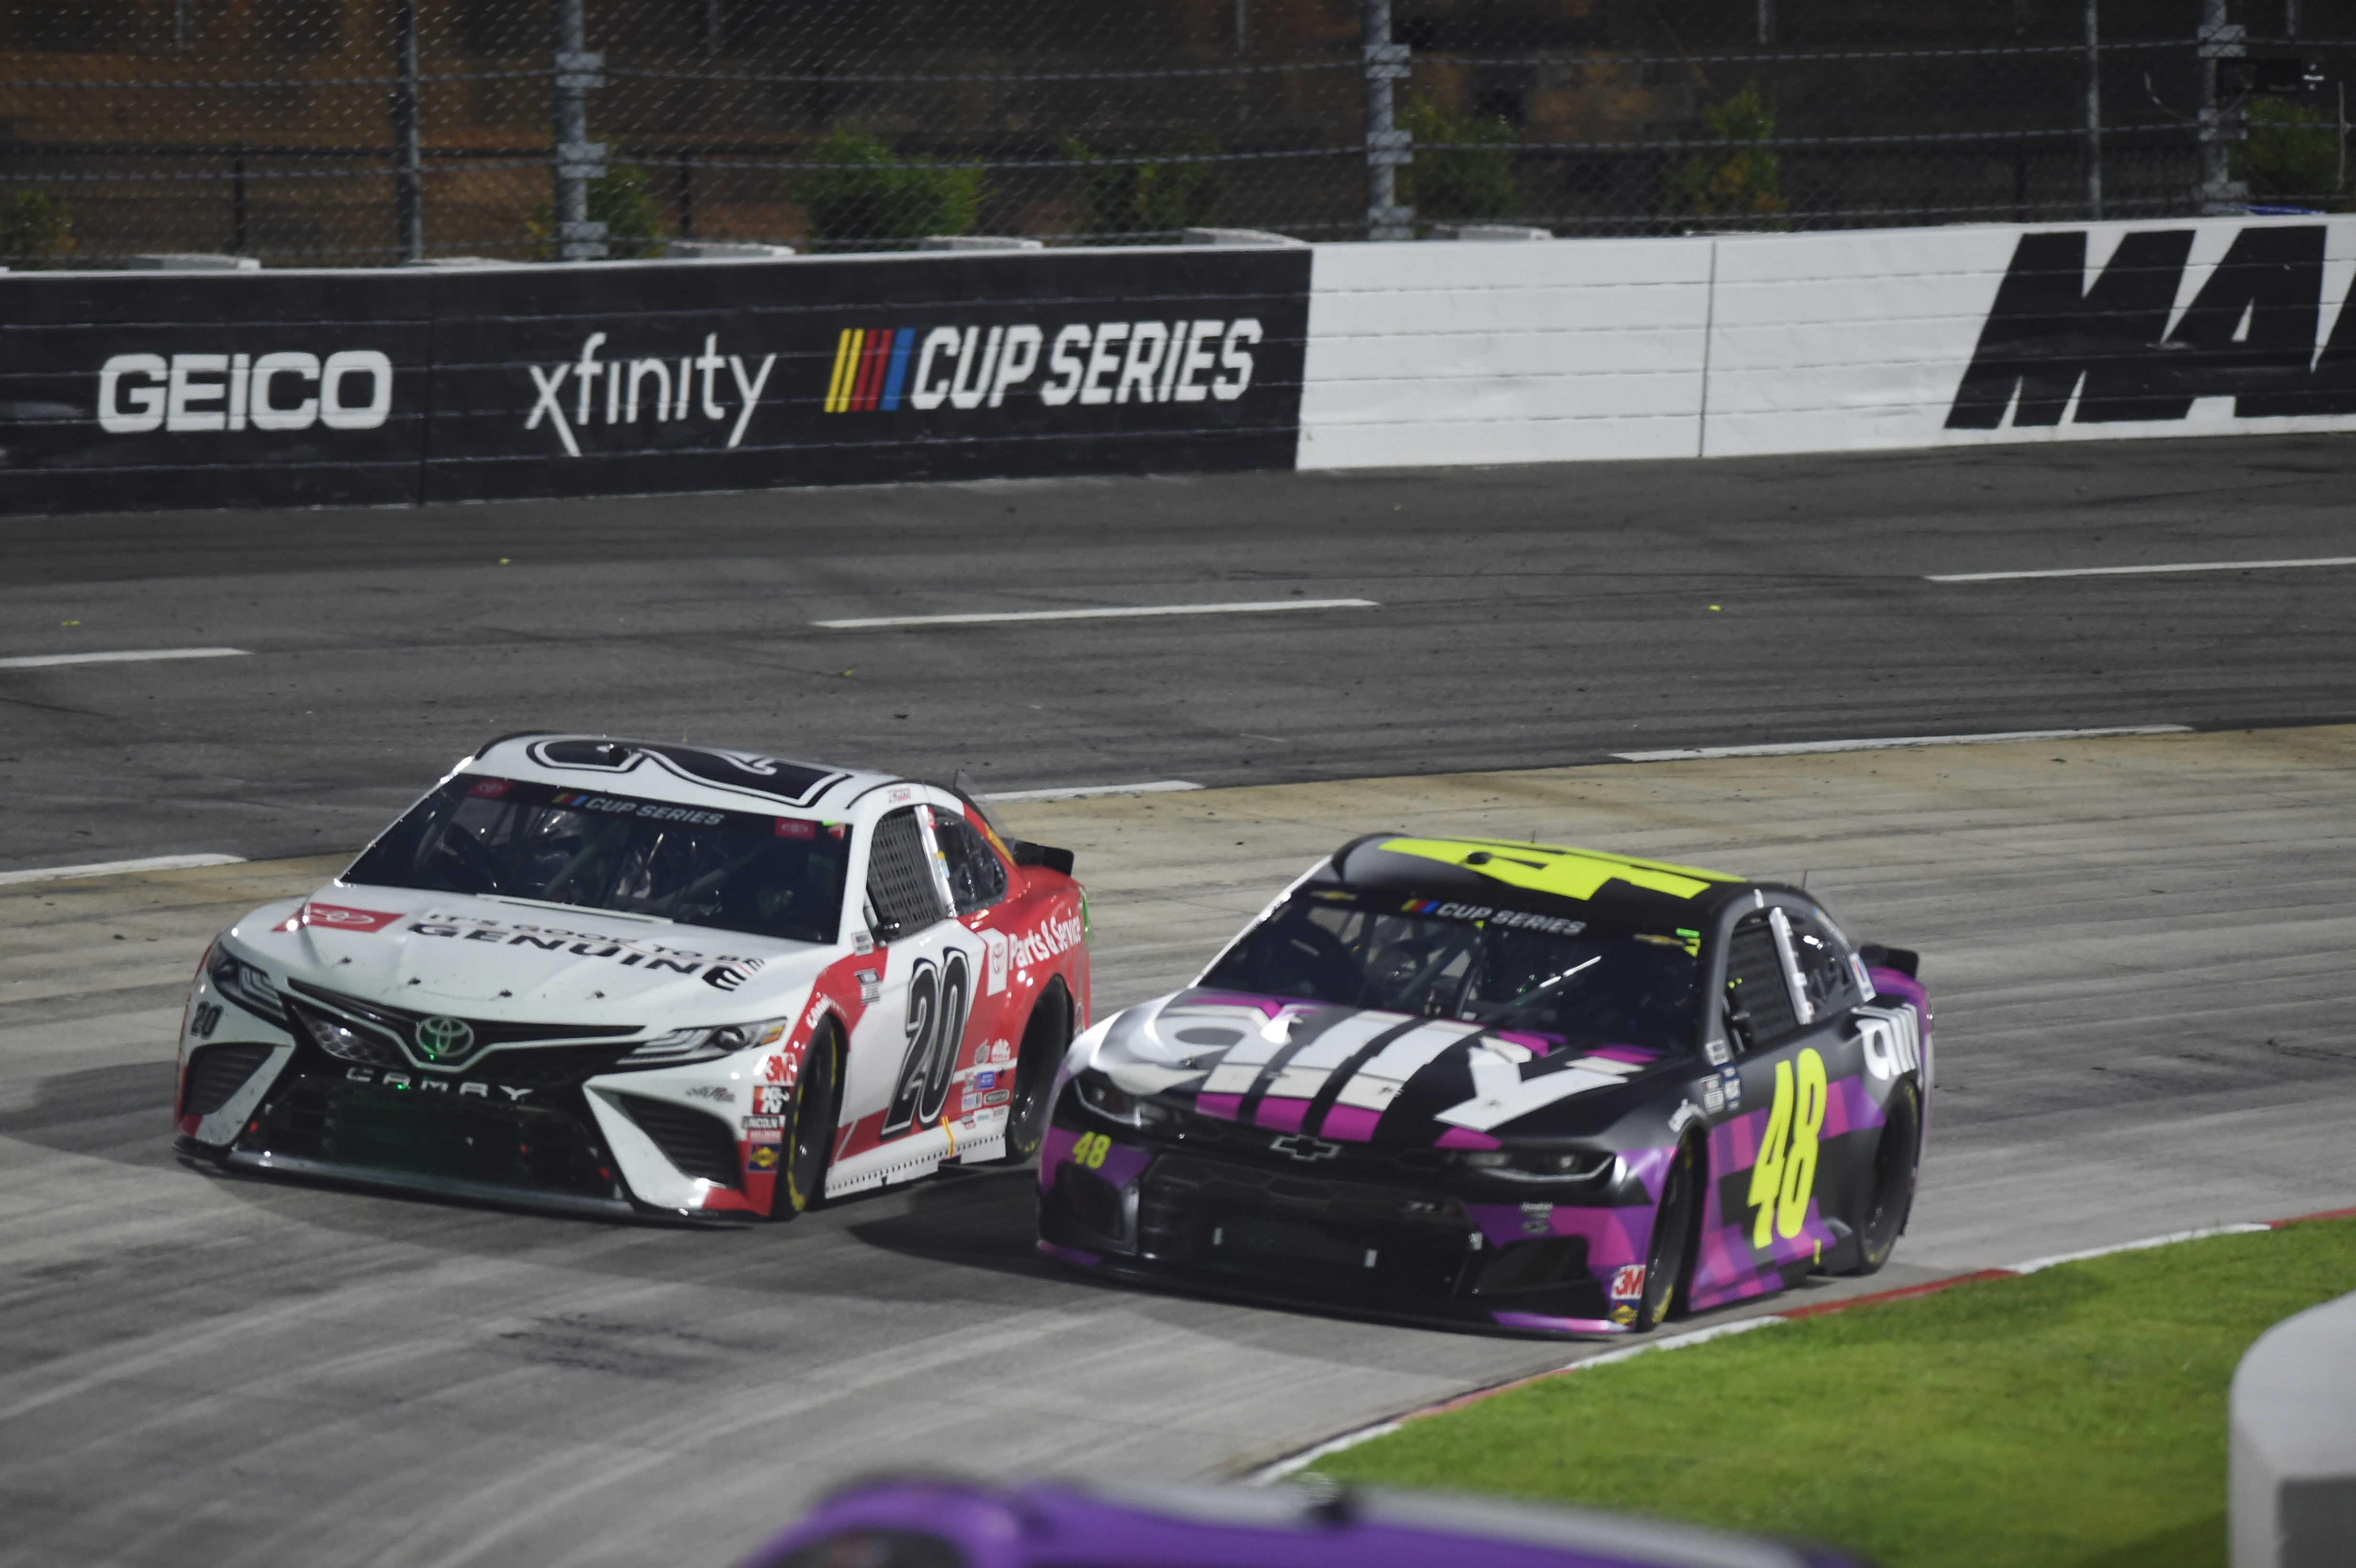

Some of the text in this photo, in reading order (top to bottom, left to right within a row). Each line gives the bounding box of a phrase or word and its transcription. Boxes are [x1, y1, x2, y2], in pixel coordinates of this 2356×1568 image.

[98, 350, 393, 434] GEICO
[525, 332, 776, 457] xfinity
[911, 318, 1264, 410] CUP SERIES
[585, 796, 725, 826] CUP SERIES
[652, 944, 704, 957] TO
[1008, 927, 1050, 971] Parts
[1050, 907, 1081, 952] Service
[1436, 902, 1587, 936] CUP SERIES
[407, 922, 747, 992] GENUINE
[190, 1001, 224, 1040] 20
[881, 944, 971, 1142] 20
[347, 1067, 534, 1101] CAMRY
[1076, 997, 1644, 1133] ally
[1072, 1131, 1112, 1169] 48
[1747, 1048, 1827, 1249] 48
[1616, 1268, 1645, 1296] 3M
